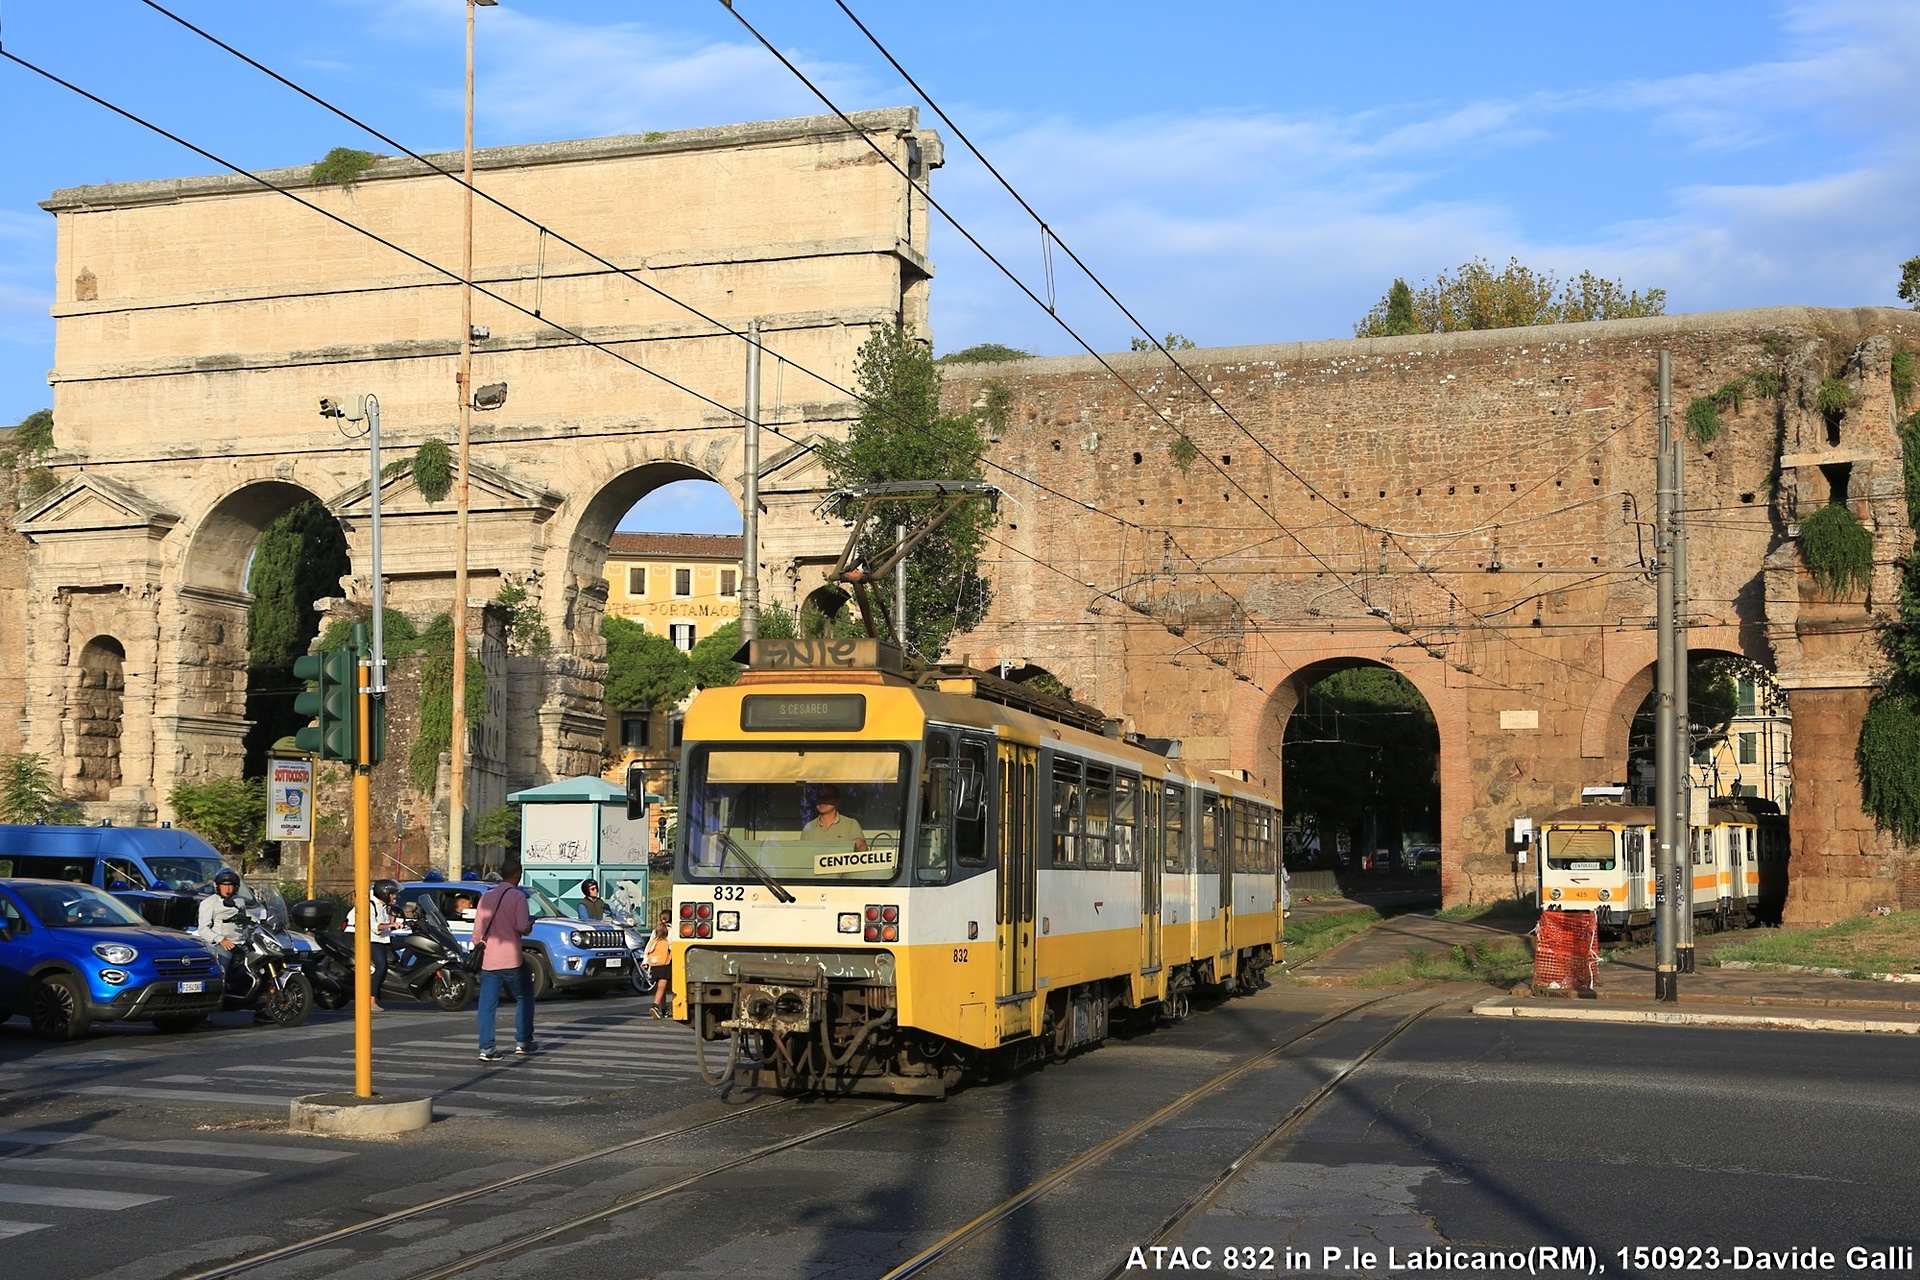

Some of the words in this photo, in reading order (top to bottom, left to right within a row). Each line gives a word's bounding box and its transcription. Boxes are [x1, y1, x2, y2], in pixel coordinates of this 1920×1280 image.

[603, 602, 640, 615] OTEL
[788, 703, 828, 715] CESAREO
[819, 852, 892, 868] CENTOCELLE
[713, 886, 745, 901] 832
[953, 948, 968, 963] 832
